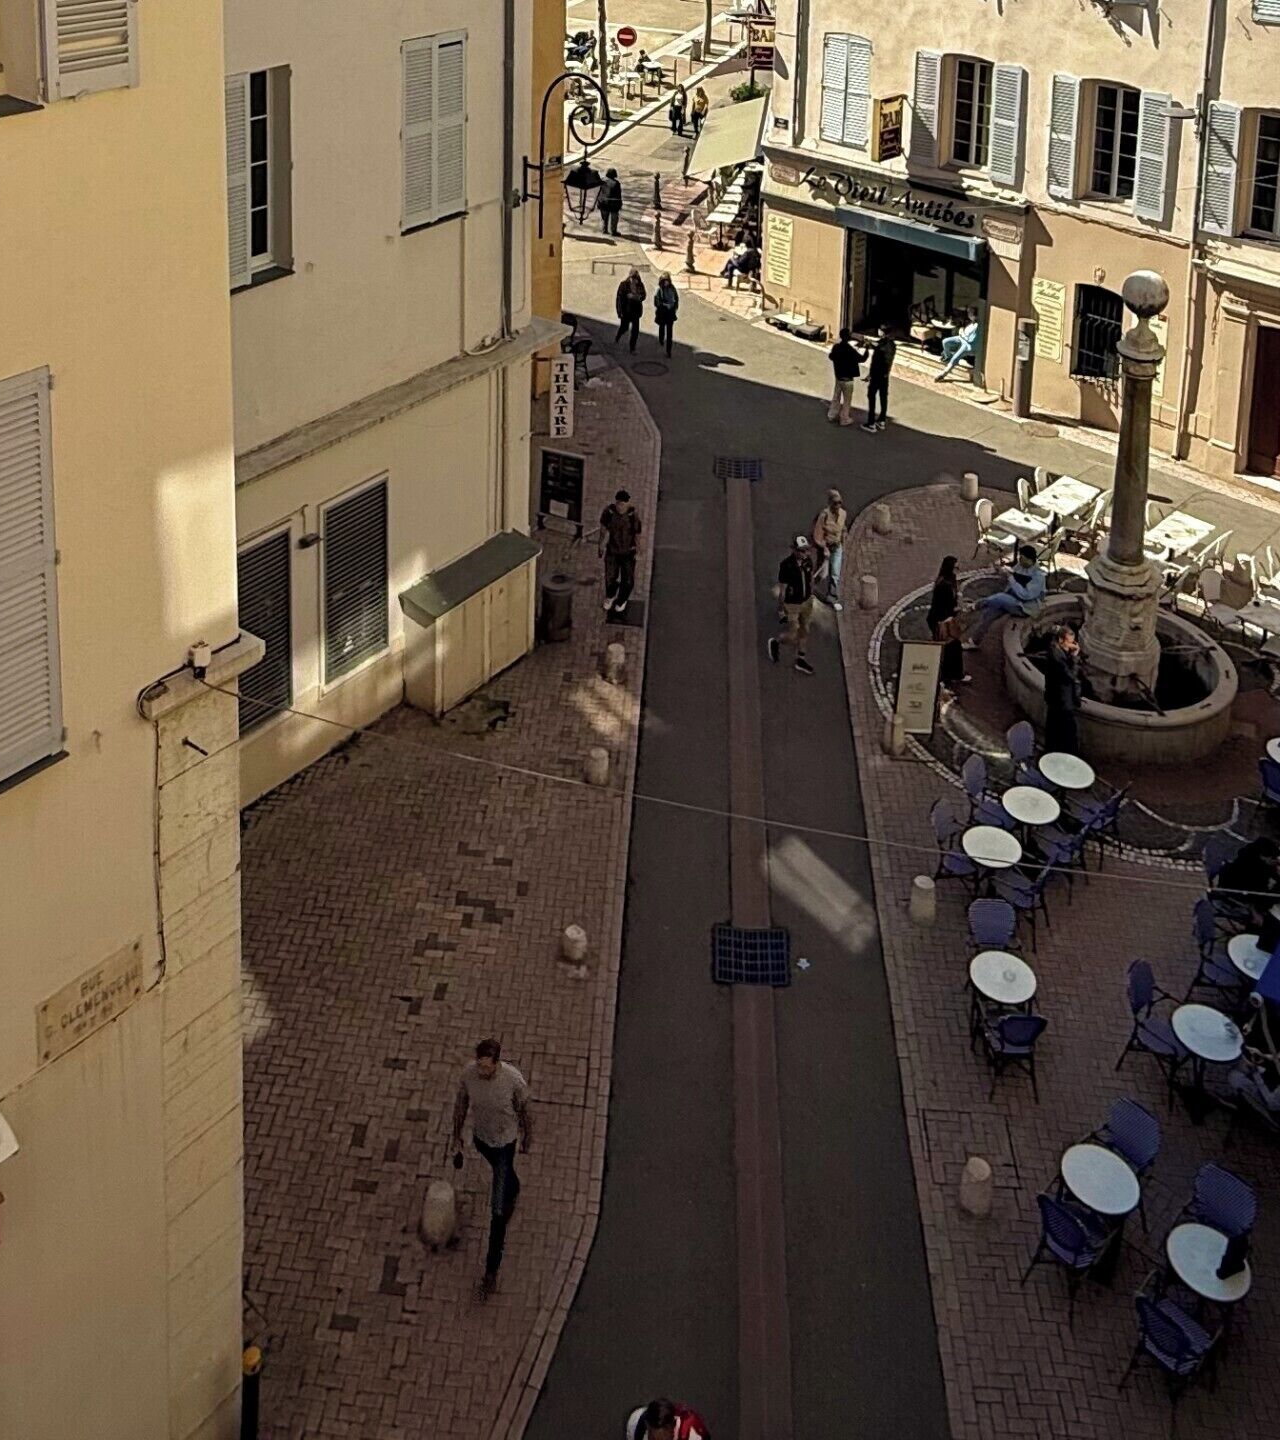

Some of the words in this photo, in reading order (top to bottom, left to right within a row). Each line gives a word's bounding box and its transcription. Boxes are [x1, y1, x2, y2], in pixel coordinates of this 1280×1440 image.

[798, 167, 826, 191] Le
[892, 190, 977, 229] Antibes
[554, 363, 569, 436] THEATRE
